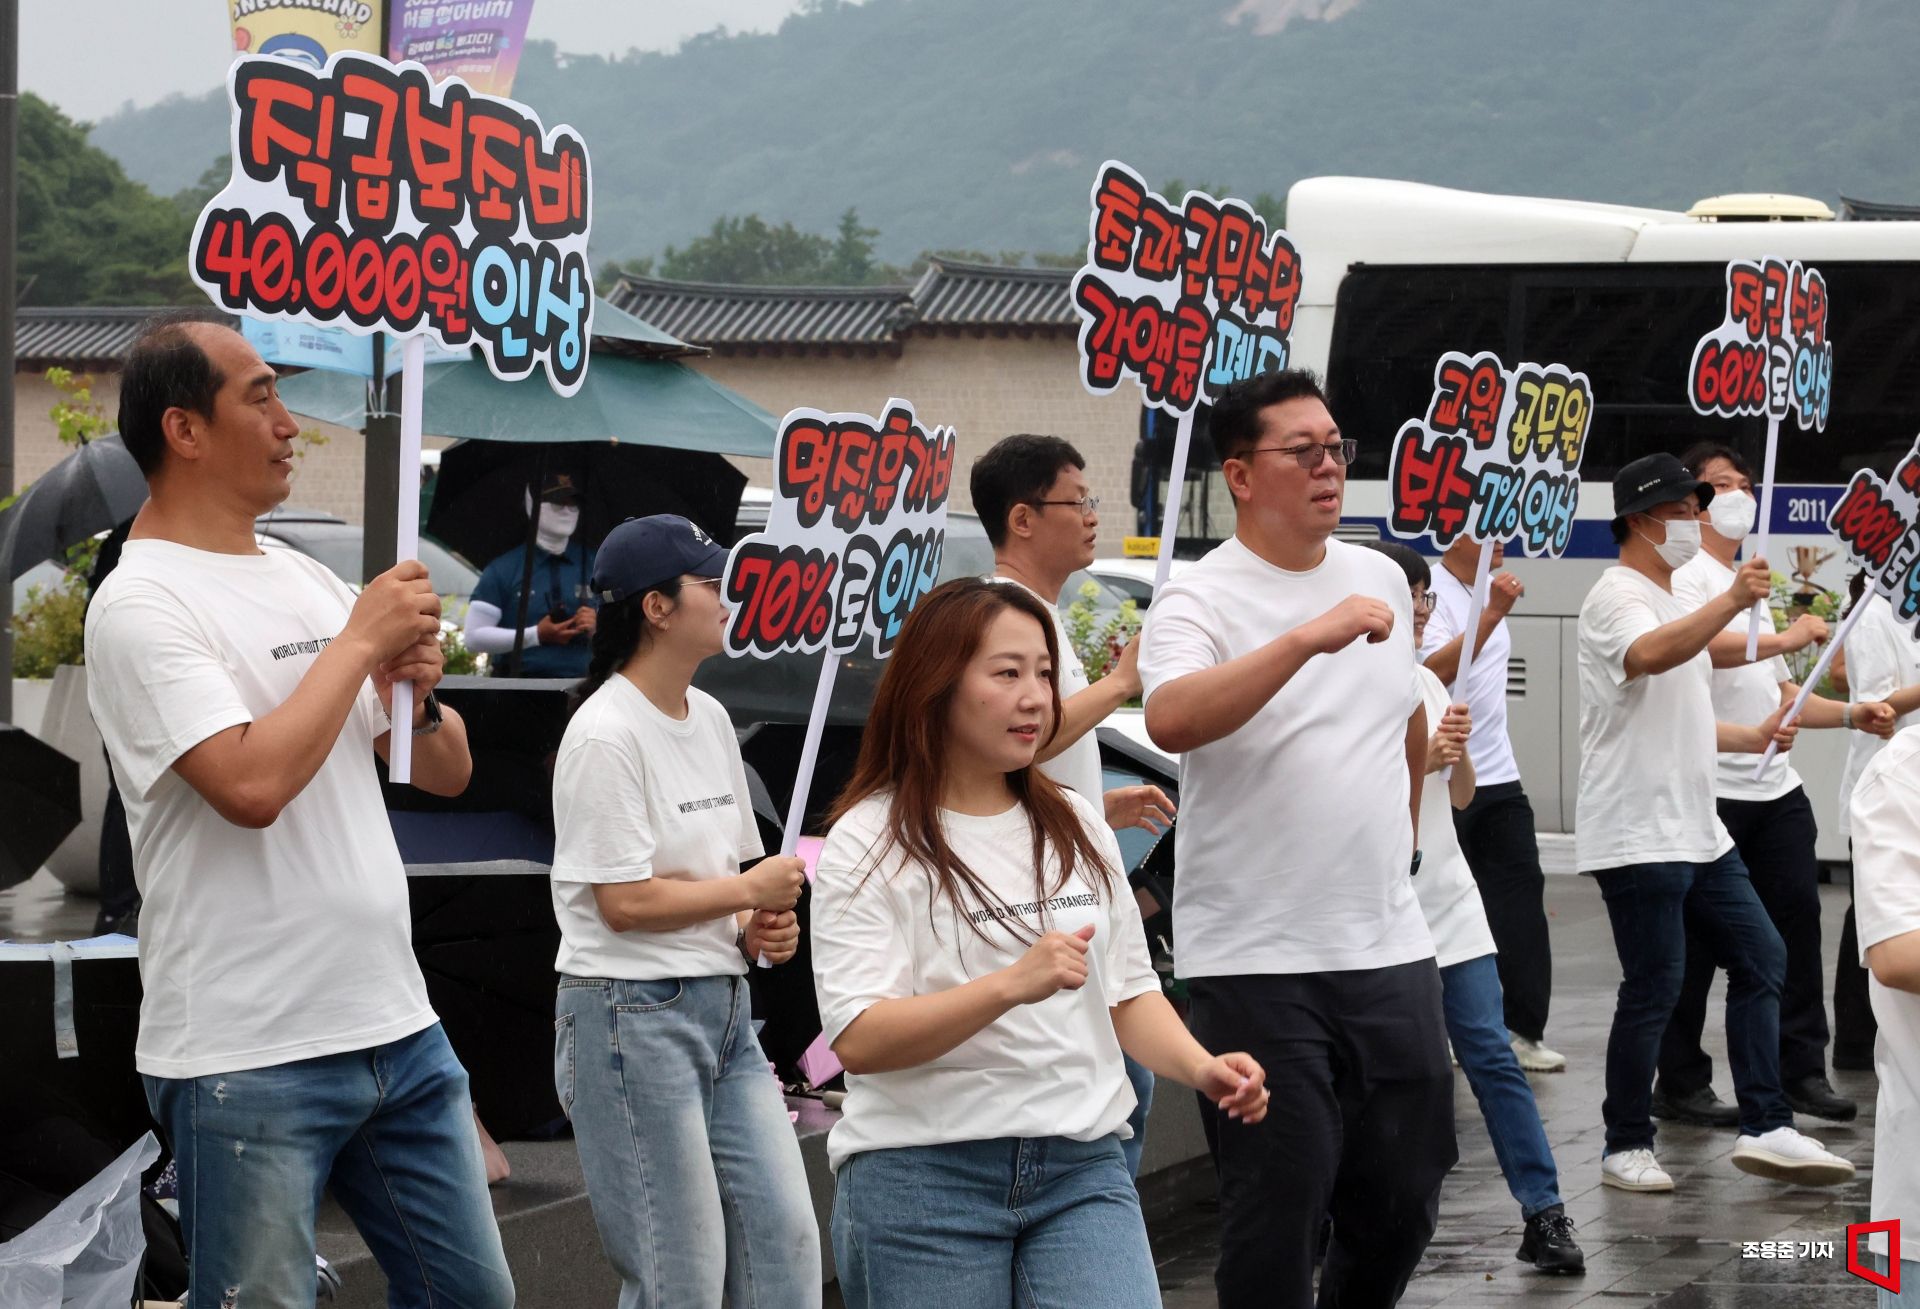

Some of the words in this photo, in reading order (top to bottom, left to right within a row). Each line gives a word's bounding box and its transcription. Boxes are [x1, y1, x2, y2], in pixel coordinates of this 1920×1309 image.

[244, 71, 584, 228] 직급보조비
[1096, 175, 1302, 334] 초과근무수당
[470, 243, 587, 372] 인상
[1432, 364, 1504, 444] 교원
[1510, 379, 1589, 464] 공무원
[1794, 345, 1832, 421] 인상
[784, 415, 957, 522] 명절휴가비
[1398, 435, 1474, 535] 보수
[1478, 469, 1524, 533] 7%
[1522, 477, 1577, 550] 인상
[1787, 498, 1827, 523] 2011
[270, 643, 297, 661] WORLD
[295, 640, 320, 654] WITHOUT
[1003, 900, 1048, 918] WITHOUT
[1048, 893, 1100, 911] STRANGERS
